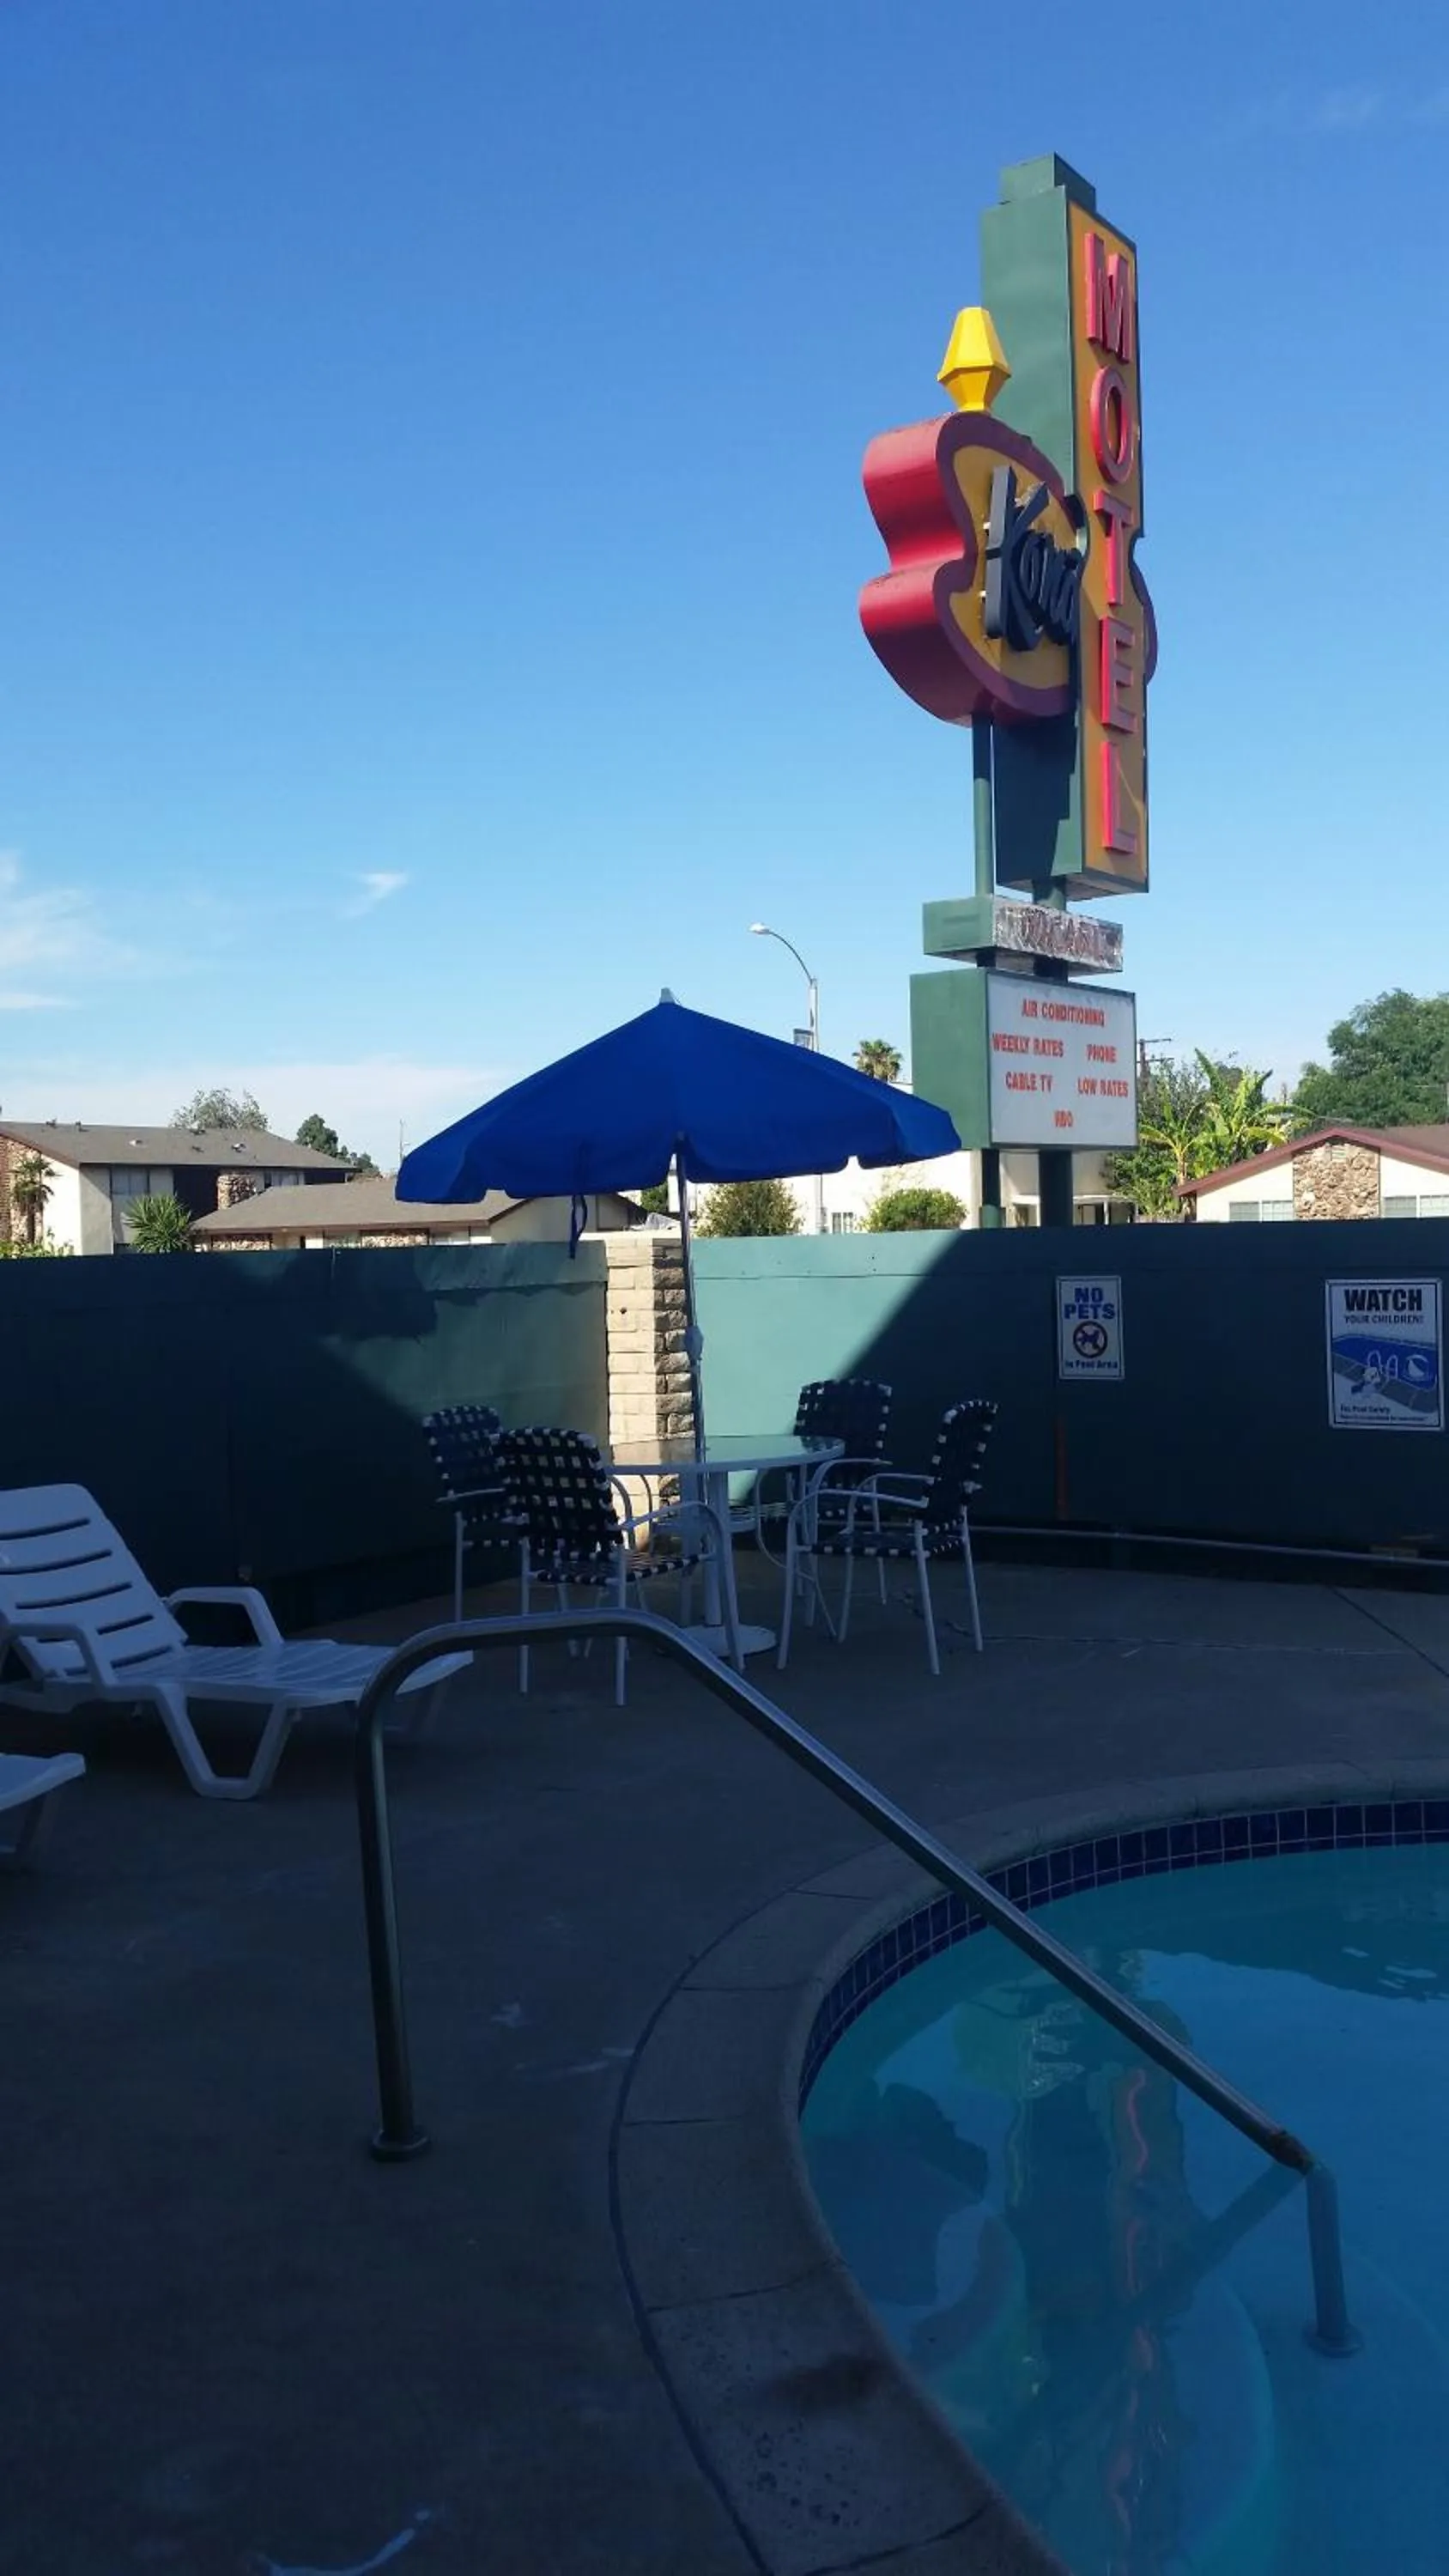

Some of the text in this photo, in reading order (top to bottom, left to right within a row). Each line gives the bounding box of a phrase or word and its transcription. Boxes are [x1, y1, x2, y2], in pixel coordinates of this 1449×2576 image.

[1084, 233, 1136, 854] MOTEL
[1022, 999, 1038, 1018] AIR
[992, 1032, 1064, 1058] WEEKLY RATES
[1086, 1043, 1117, 1064] PHONE
[1005, 1072, 1053, 1092] CABLE TV
[1077, 1077, 1129, 1098] LOW RATES
[1054, 1109, 1074, 1128] HBO
[1074, 1287, 1104, 1303] NO
[1343, 1288, 1422, 1312] WATCH
[1064, 1303, 1115, 1320] PETS
[1343, 1314, 1370, 1324] YOUR
